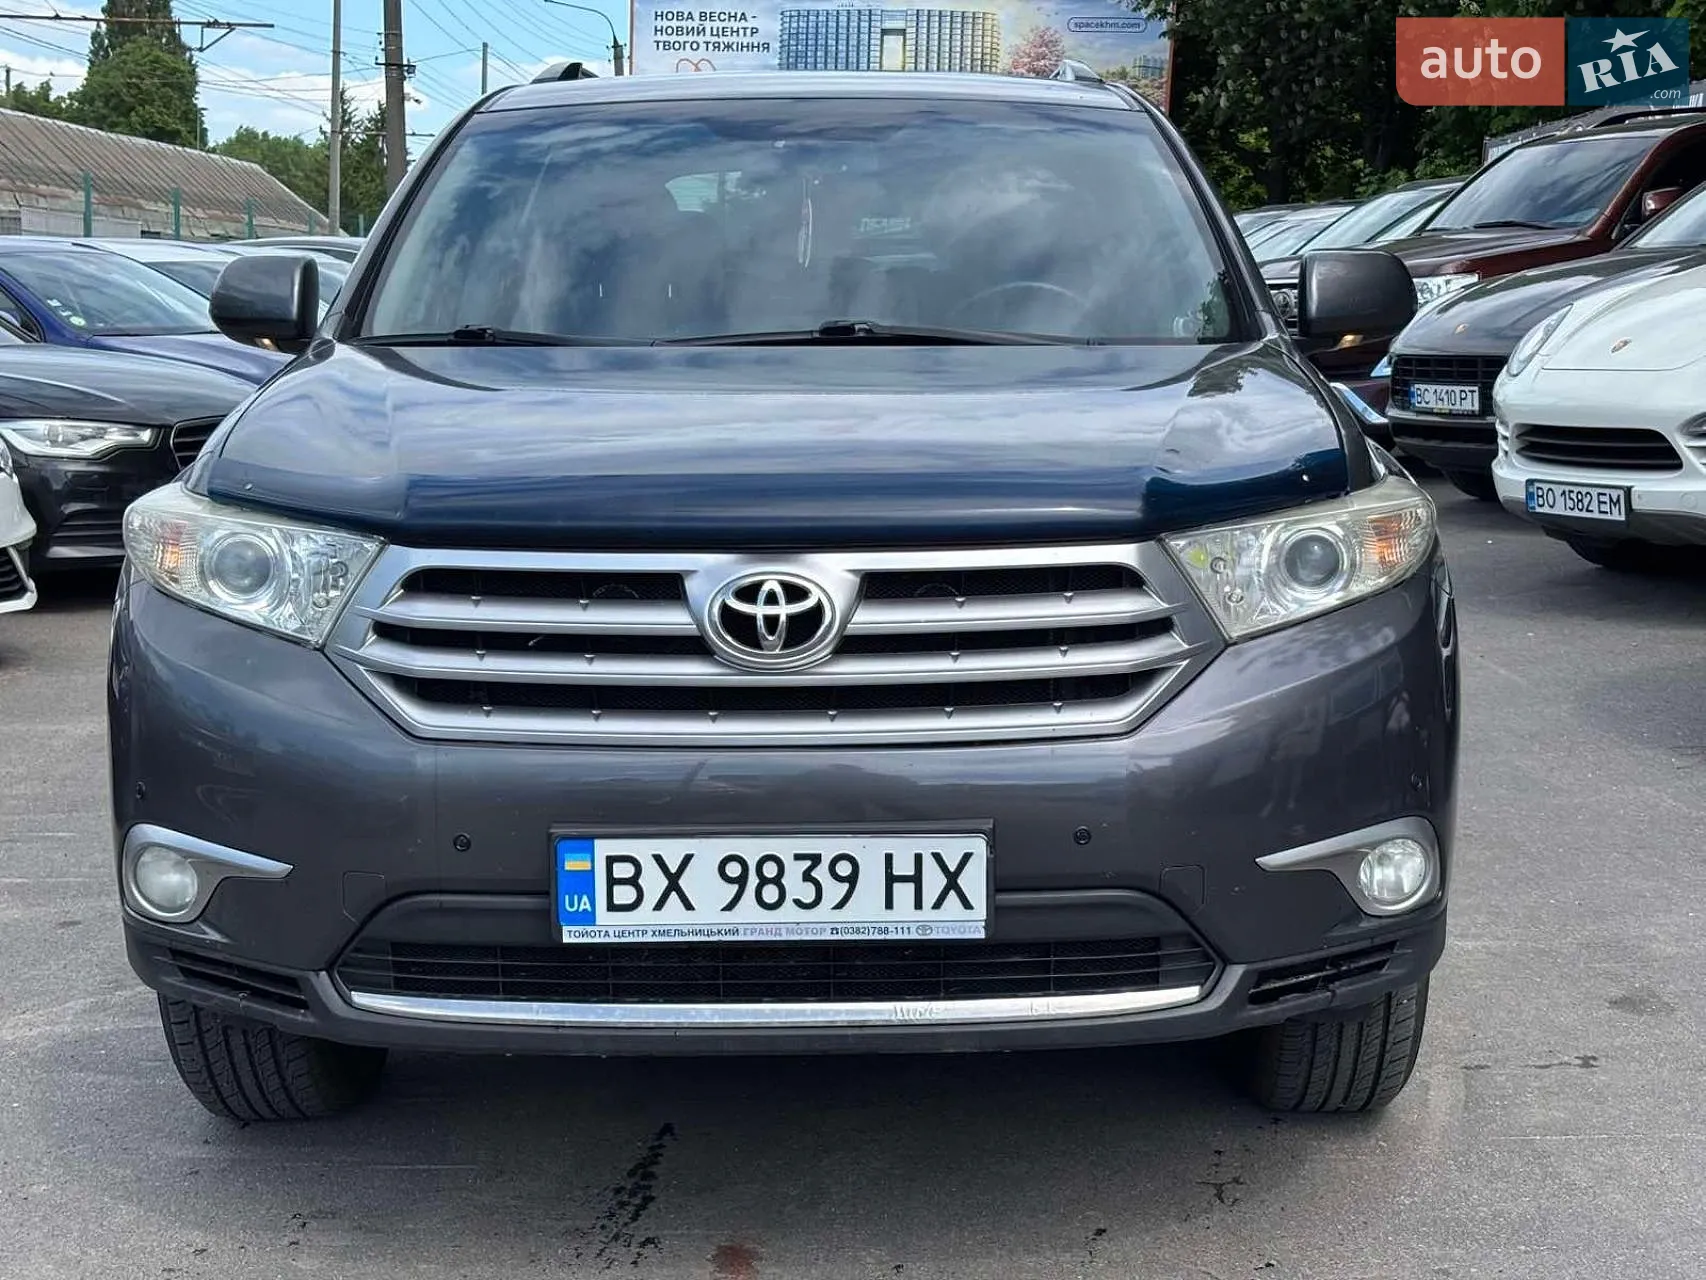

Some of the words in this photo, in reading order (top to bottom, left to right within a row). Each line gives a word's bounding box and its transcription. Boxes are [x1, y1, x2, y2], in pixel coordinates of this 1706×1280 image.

[654, 11, 695, 22] НОВА
[699, 11, 748, 22] ВЕСНА
[654, 24, 706, 37] НОВИЙ
[710, 26, 759, 38] ЦЕНТР
[1074, 20, 1141, 30] spacekhm.com
[654, 40, 700, 51] ТВОГО
[703, 41, 770, 53] ТЯЖІННЯ
[1416, 387, 1430, 405] BC
[1433, 388, 1457, 406] 1410
[1459, 389, 1476, 407] PT
[1536, 486, 1556, 509] BO
[1560, 489, 1594, 513] 1582
[1597, 492, 1622, 516] EM
[605, 853, 695, 912] BX
[717, 853, 860, 912] 9839
[884, 852, 975, 911] HX
[565, 895, 591, 913] UA
[567, 927, 610, 939] ТОЙОТА
[613, 928, 648, 939] ЦЕНТР
[651, 926, 739, 938] ХМЕЛЬНИЦЬКИЙ
[742, 927, 783, 938] ГРАНД
[786, 926, 827, 937] МОТОР
[839, 925, 911, 936] (0382)788-111
